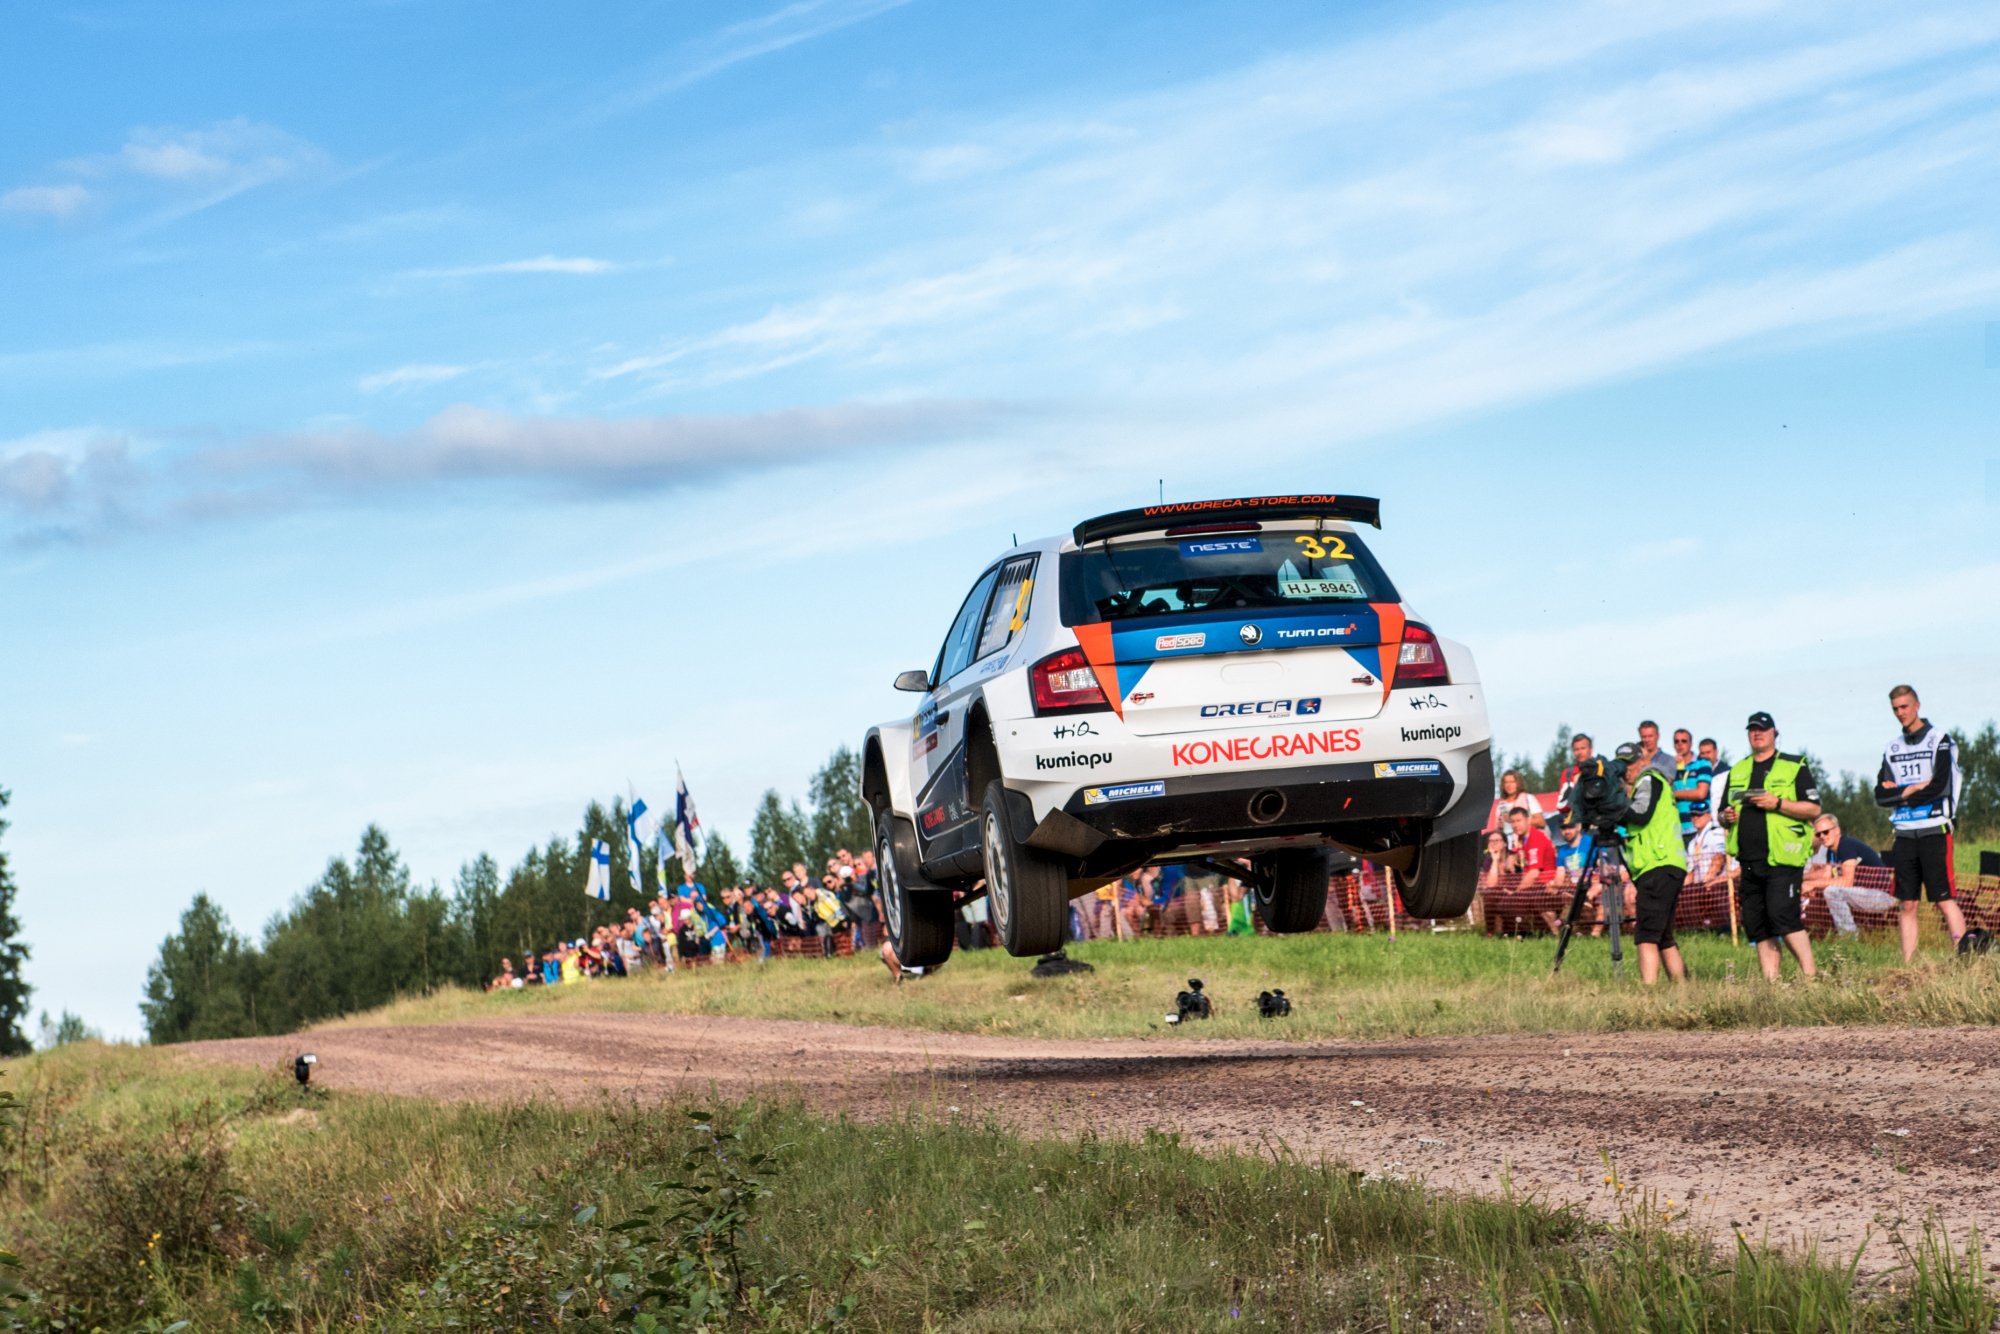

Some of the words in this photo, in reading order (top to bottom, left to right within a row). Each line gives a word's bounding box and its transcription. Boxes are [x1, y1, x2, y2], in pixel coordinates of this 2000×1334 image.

[1144, 495, 1336, 516] WWW.ORECA-STORE.COM
[1190, 540, 1252, 553] NESTE
[1295, 535, 1355, 560] 32
[1277, 629, 1315, 638] TURN
[1317, 627, 1345, 636] ONE
[1200, 700, 1292, 717] ORECA
[1408, 693, 1448, 710] HiQ
[1053, 721, 1099, 739] HiQ
[1401, 724, 1461, 742] kumiapu
[1171, 728, 1361, 766] KONECRANES
[1036, 751, 1112, 770] kumiapu
[1396, 764, 1439, 772] MICHELIN
[1900, 763, 1921, 778] 311
[1108, 784, 1163, 797] MICHELIN
